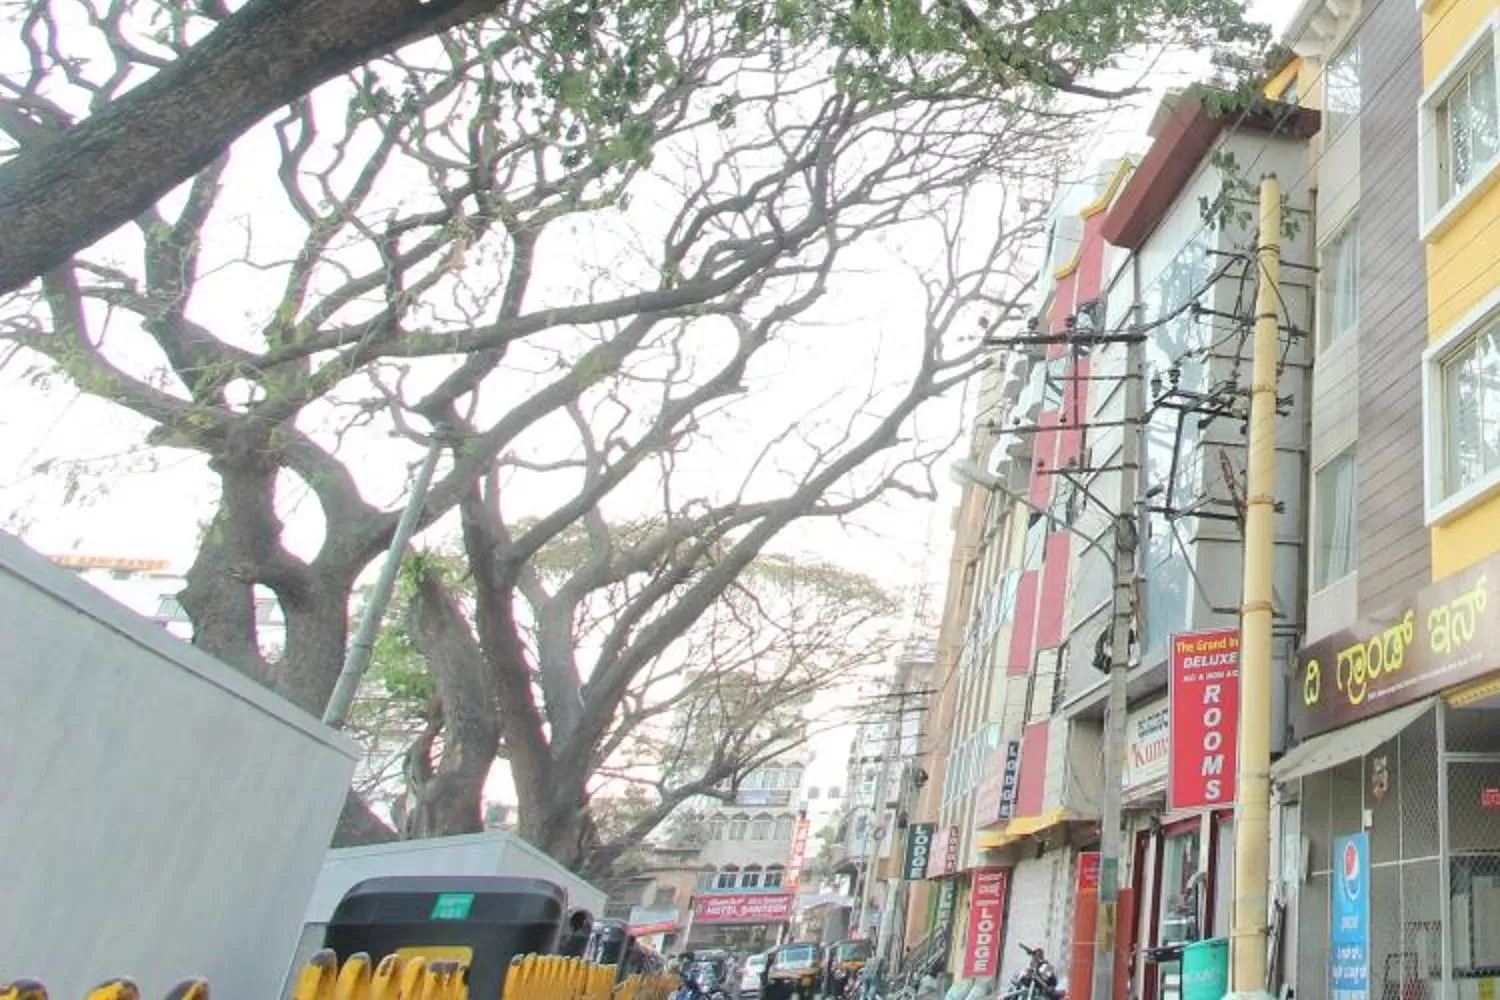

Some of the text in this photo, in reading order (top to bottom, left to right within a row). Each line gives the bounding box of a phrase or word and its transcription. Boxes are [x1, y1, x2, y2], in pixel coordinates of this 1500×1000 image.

[1176, 641, 1195, 653] The
[1196, 637, 1227, 651] Grand
[1184, 652, 1238, 669] DELUXE
[1202, 684, 1224, 800] ROOMS
[911, 827, 929, 879] LODGE
[974, 907, 995, 972] LODGE
